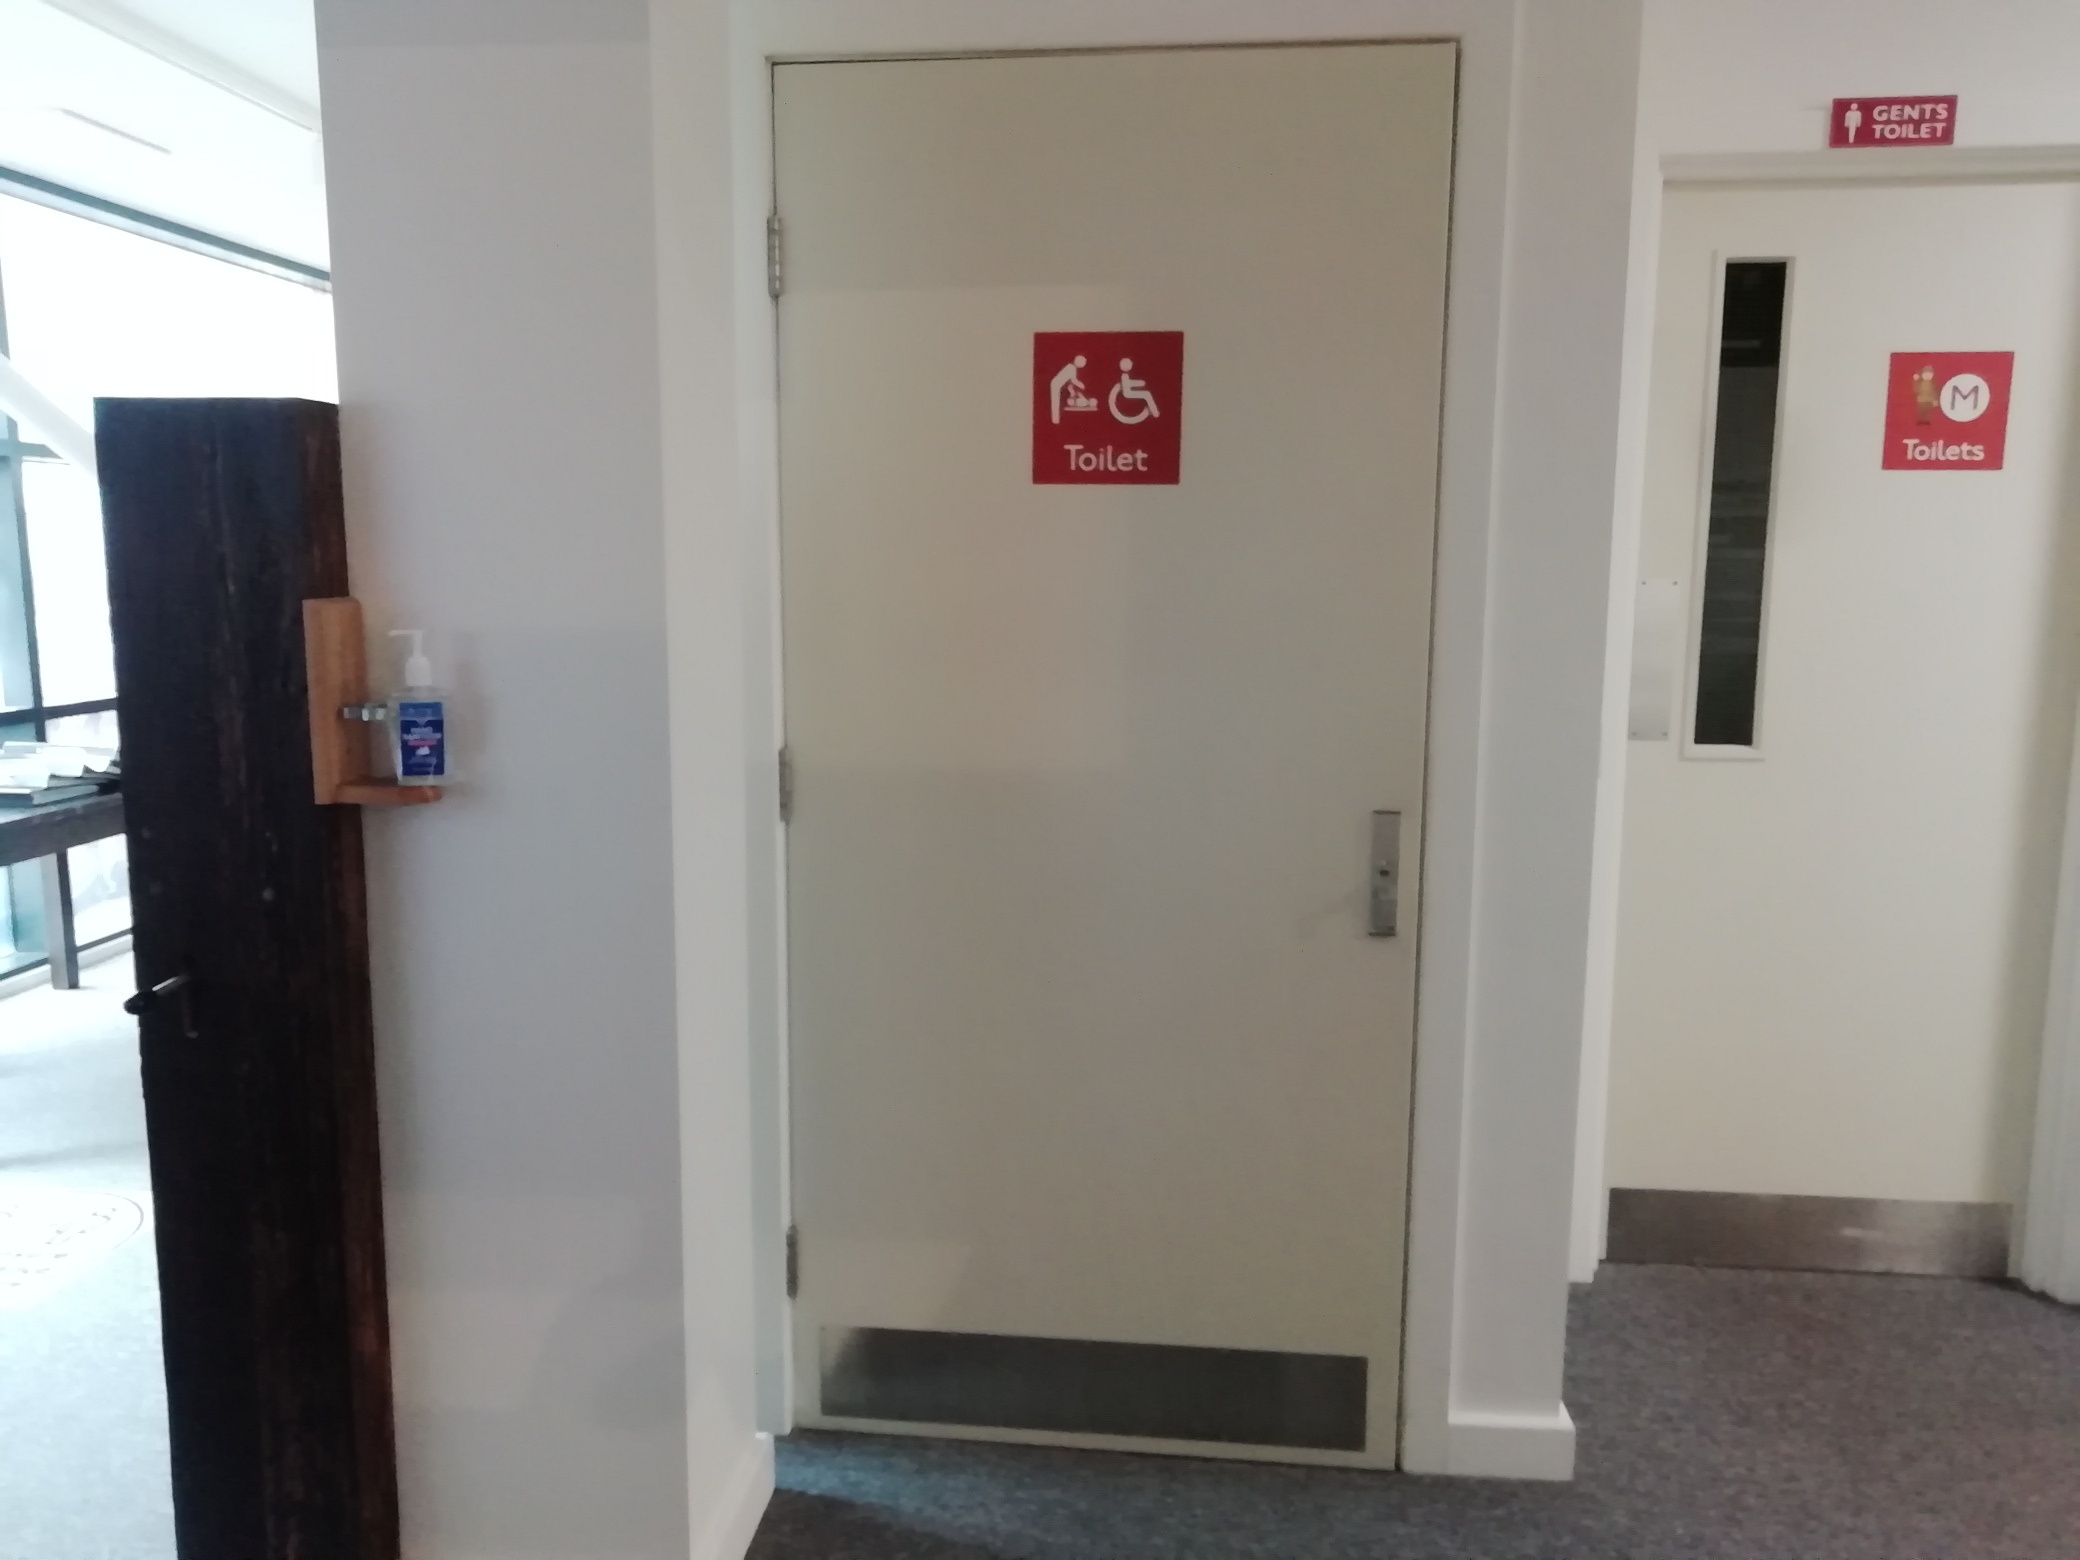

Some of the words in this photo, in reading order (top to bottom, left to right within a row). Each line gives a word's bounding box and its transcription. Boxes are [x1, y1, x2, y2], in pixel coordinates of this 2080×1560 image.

[1872, 103, 1949, 121] GENTS
[1871, 122, 1947, 139] TOILET
[1950, 385, 1980, 411] M
[1063, 444, 1149, 472] Toilet
[1902, 438, 1985, 461] Toilets
